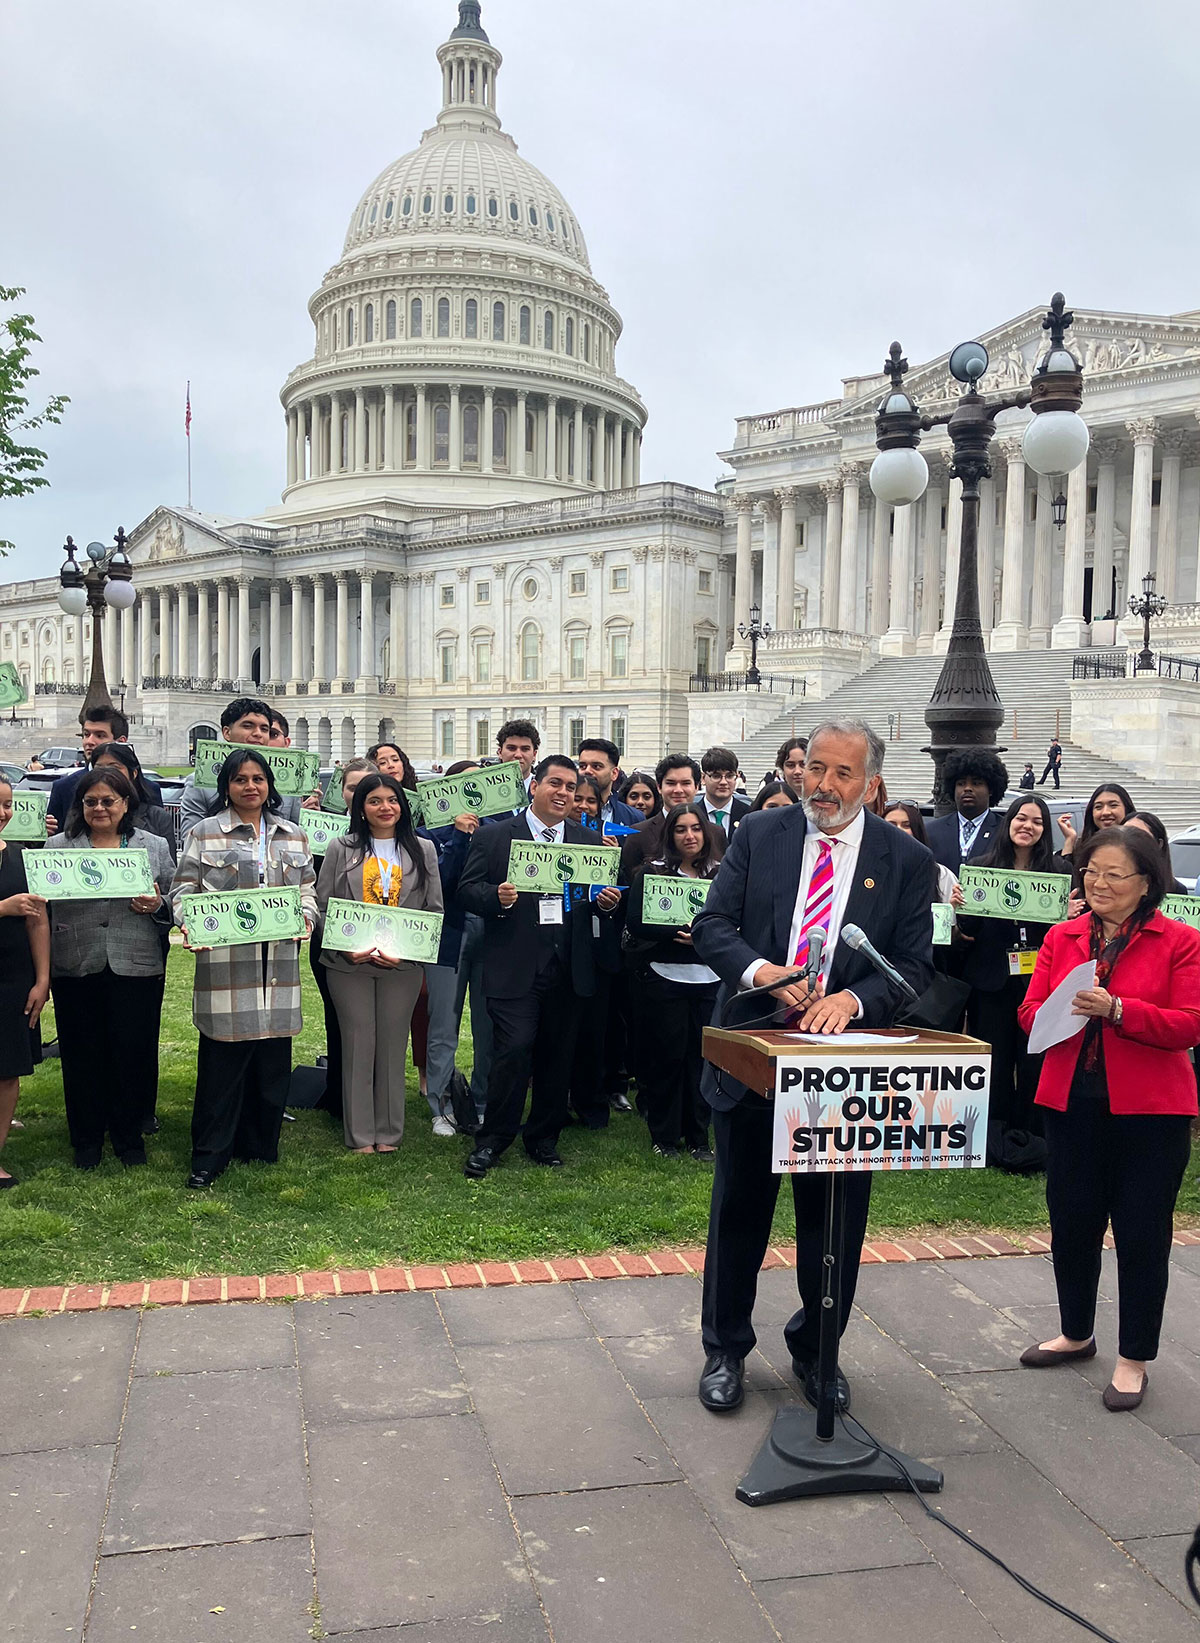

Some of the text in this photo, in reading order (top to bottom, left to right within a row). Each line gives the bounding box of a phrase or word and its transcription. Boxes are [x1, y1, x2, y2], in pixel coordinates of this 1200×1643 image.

[205, 750, 229, 761] FUN
[268, 756, 295, 768] HSIs
[426, 785, 458, 800] FUND
[485, 773, 511, 787] MSIs
[307, 818, 339, 831] FUND
[34, 859, 73, 869] FUND
[107, 858, 137, 868] MSIs
[518, 851, 553, 863] FUND
[582, 855, 608, 867] MSIs
[651, 885, 684, 896] FUND
[966, 876, 1000, 888] FUND
[1030, 882, 1057, 894] MSIs
[192, 903, 230, 915] FUND
[261, 897, 290, 909] MSIs
[1166, 904, 1200, 916] FUND
[335, 909, 371, 923] FUND
[401, 918, 429, 932] MSIs
[781, 1065, 986, 1093] PROTECTING
[841, 1095, 913, 1122] OUR
[792, 1124, 967, 1153] STUDENTS
[858, 1156, 896, 1164] MINORITY
[897, 1155, 930, 1163] SERVING
[931, 1154, 982, 1162] INSTITUTIONS
